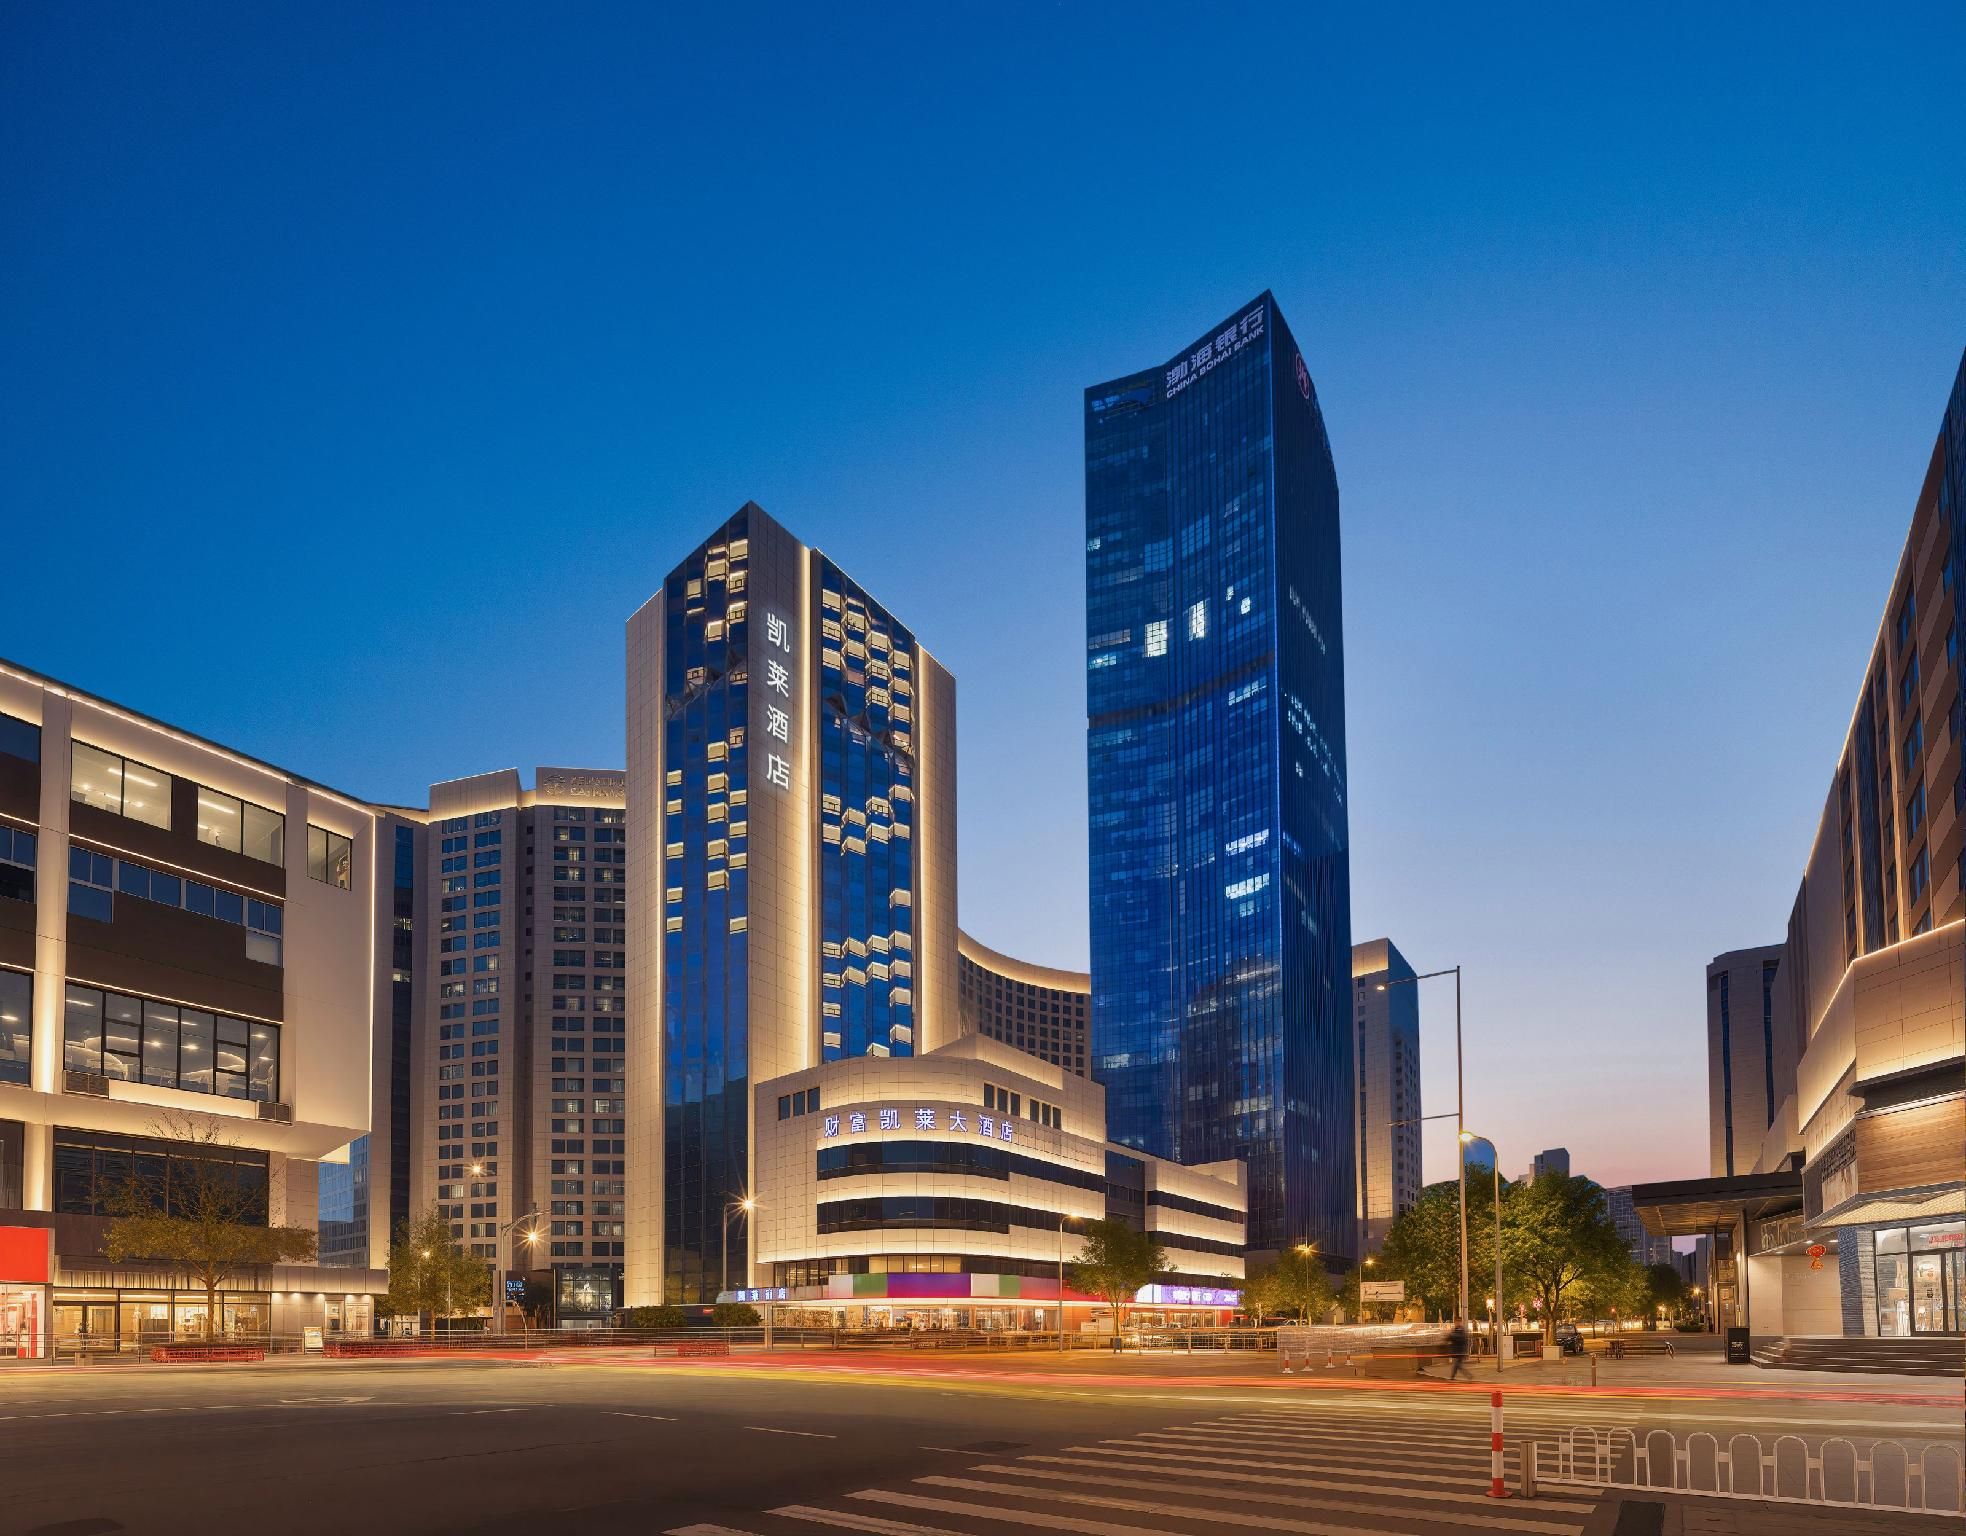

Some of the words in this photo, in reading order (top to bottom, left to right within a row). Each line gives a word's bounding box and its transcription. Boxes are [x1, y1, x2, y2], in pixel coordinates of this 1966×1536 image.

[1166, 304, 1264, 388] 渤海银行
[1166, 373, 1198, 399] CHINA
[1199, 347, 1232, 376] BOHAI
[1234, 324, 1264, 351] BANK
[766, 612, 790, 790] 凯莱酒店
[823, 1108, 1014, 1143] 财富凯莱大酒店
